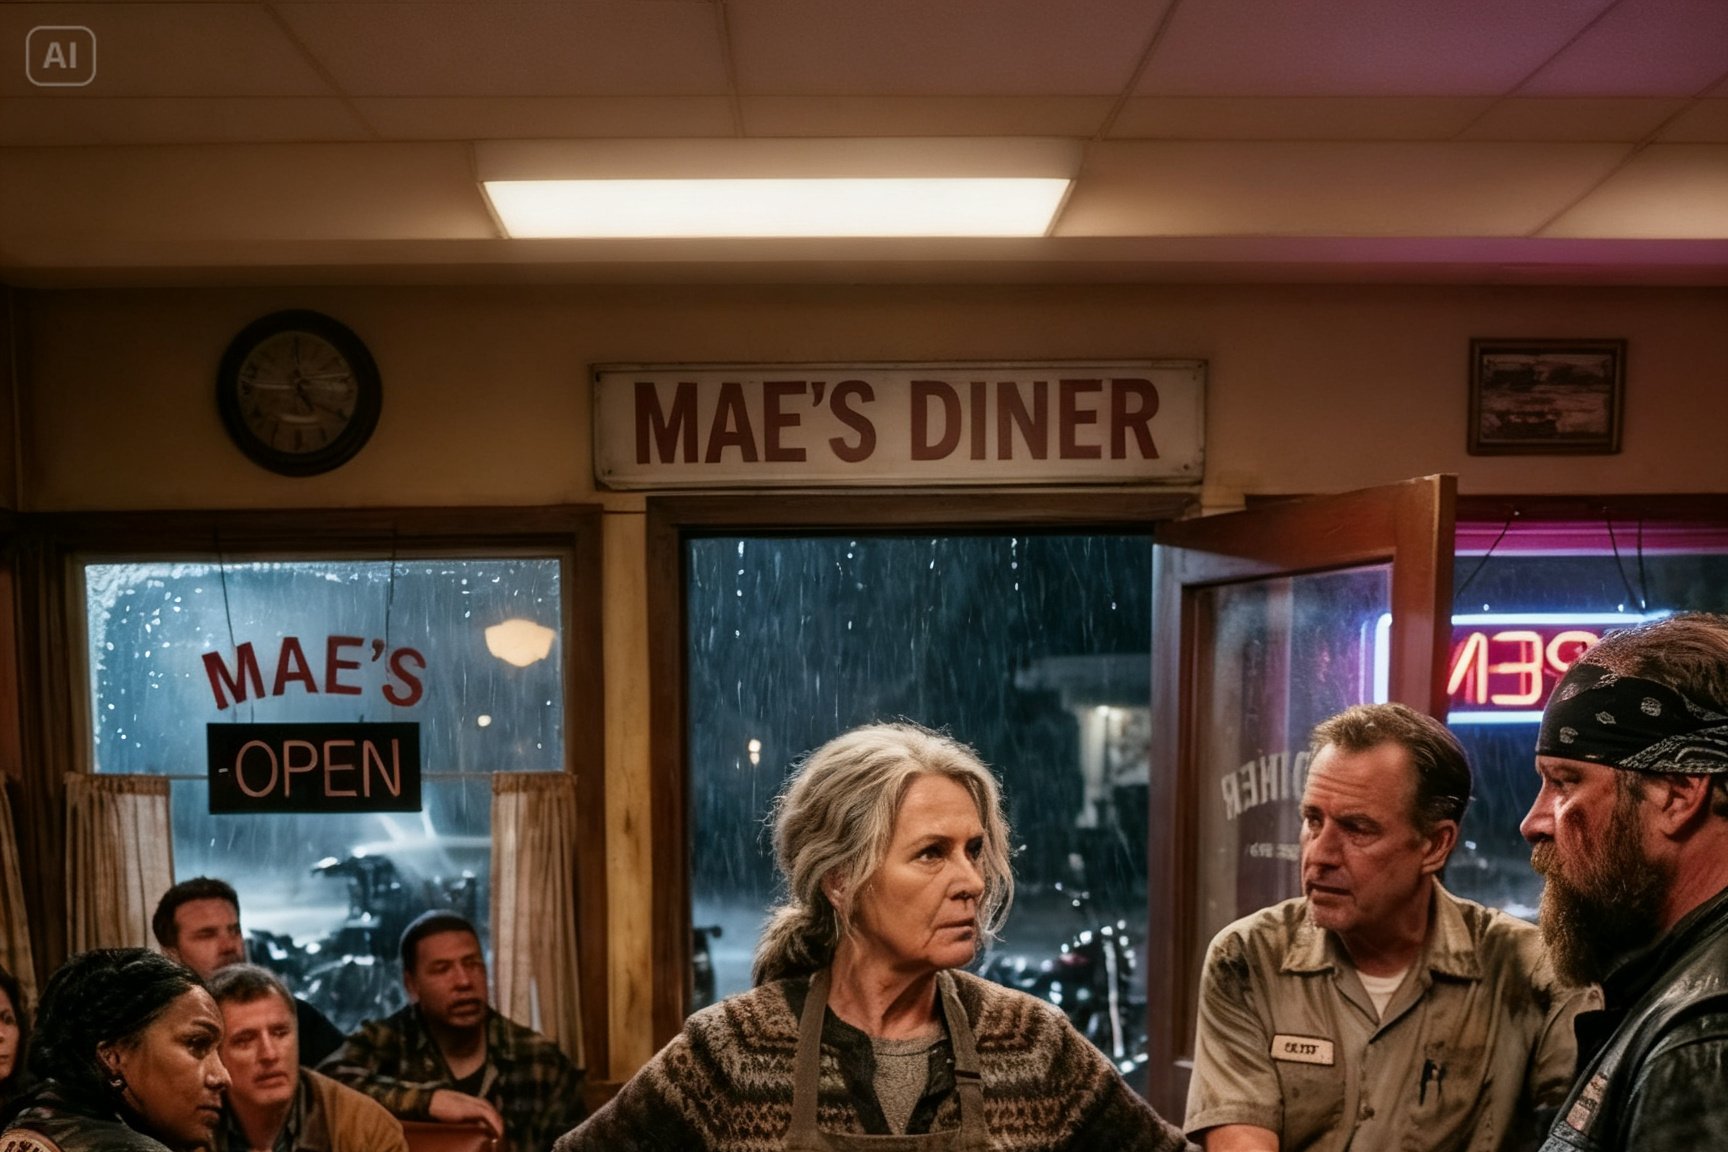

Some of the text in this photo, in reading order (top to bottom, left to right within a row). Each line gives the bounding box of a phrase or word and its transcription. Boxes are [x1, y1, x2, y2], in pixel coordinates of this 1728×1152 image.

[633, 377, 1160, 465] MAE'S DINER
[201, 635, 427, 711] MAE'S
[235, 738, 401, 798] OPEN
